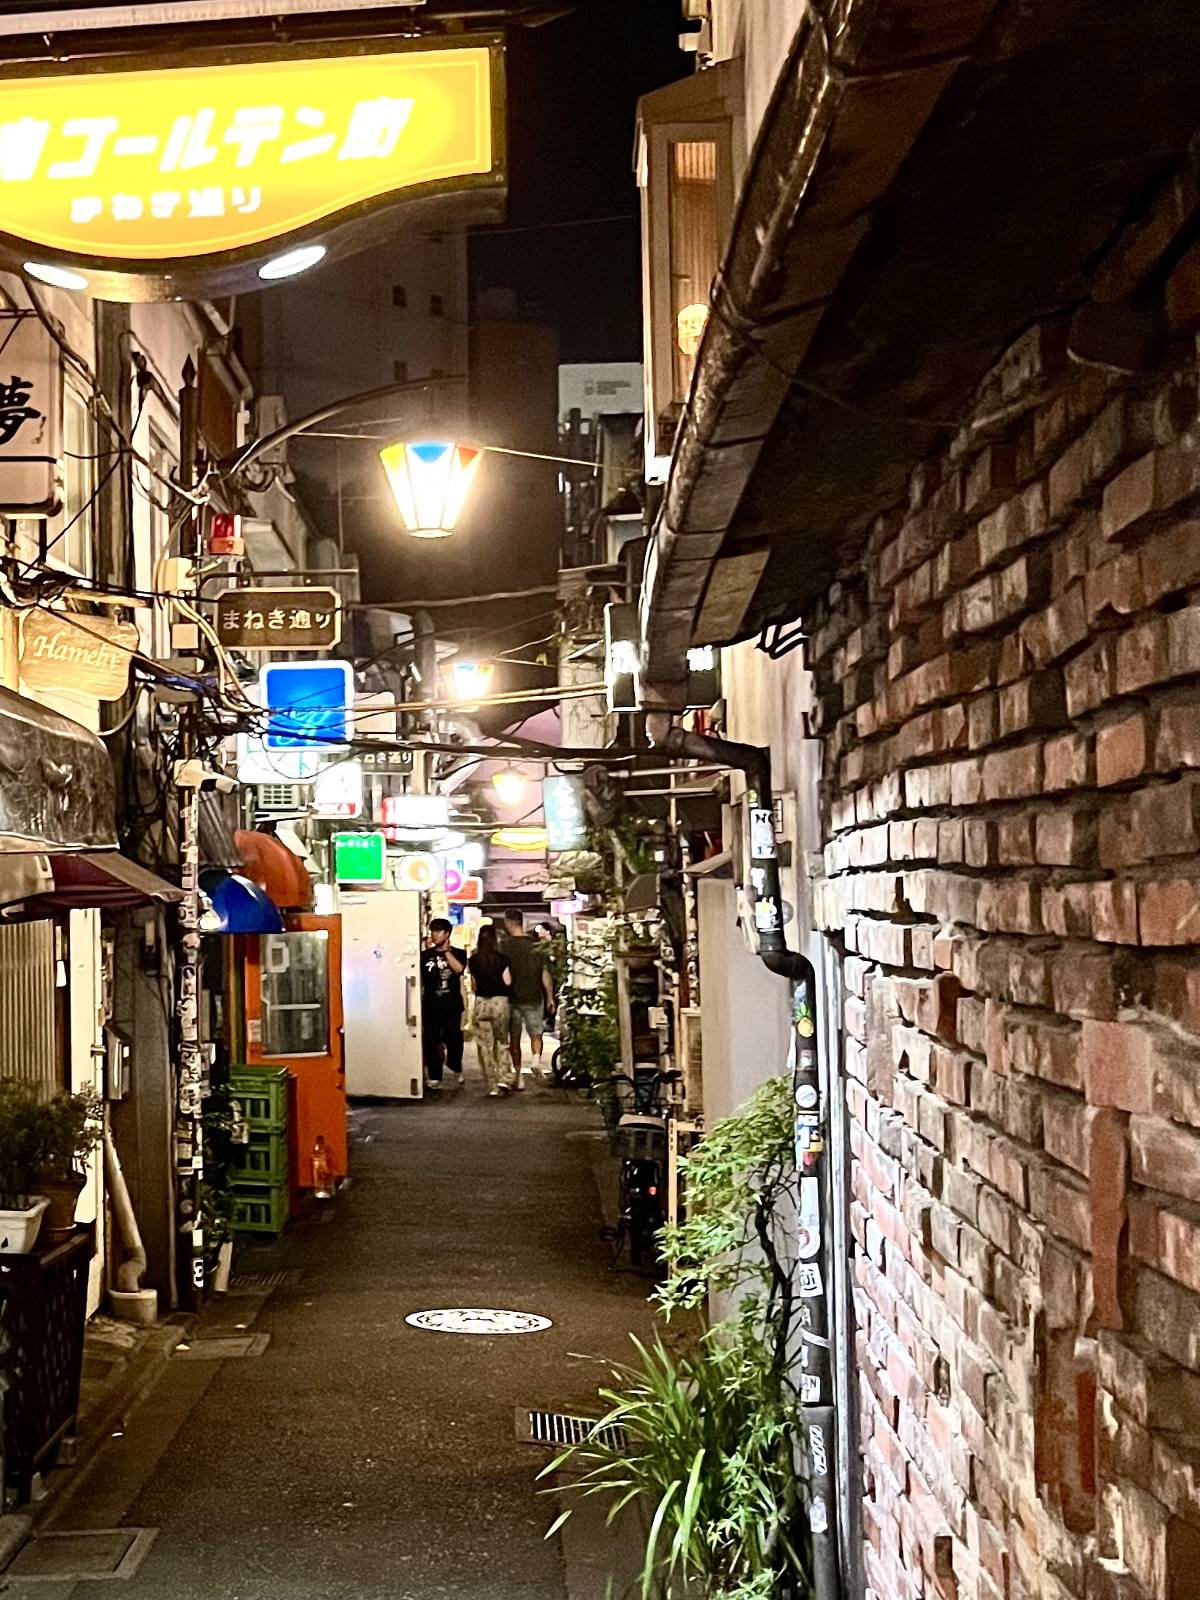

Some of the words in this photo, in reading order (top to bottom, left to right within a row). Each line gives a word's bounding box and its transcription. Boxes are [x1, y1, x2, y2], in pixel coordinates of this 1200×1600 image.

[222, 607, 331, 630] まねき通り
